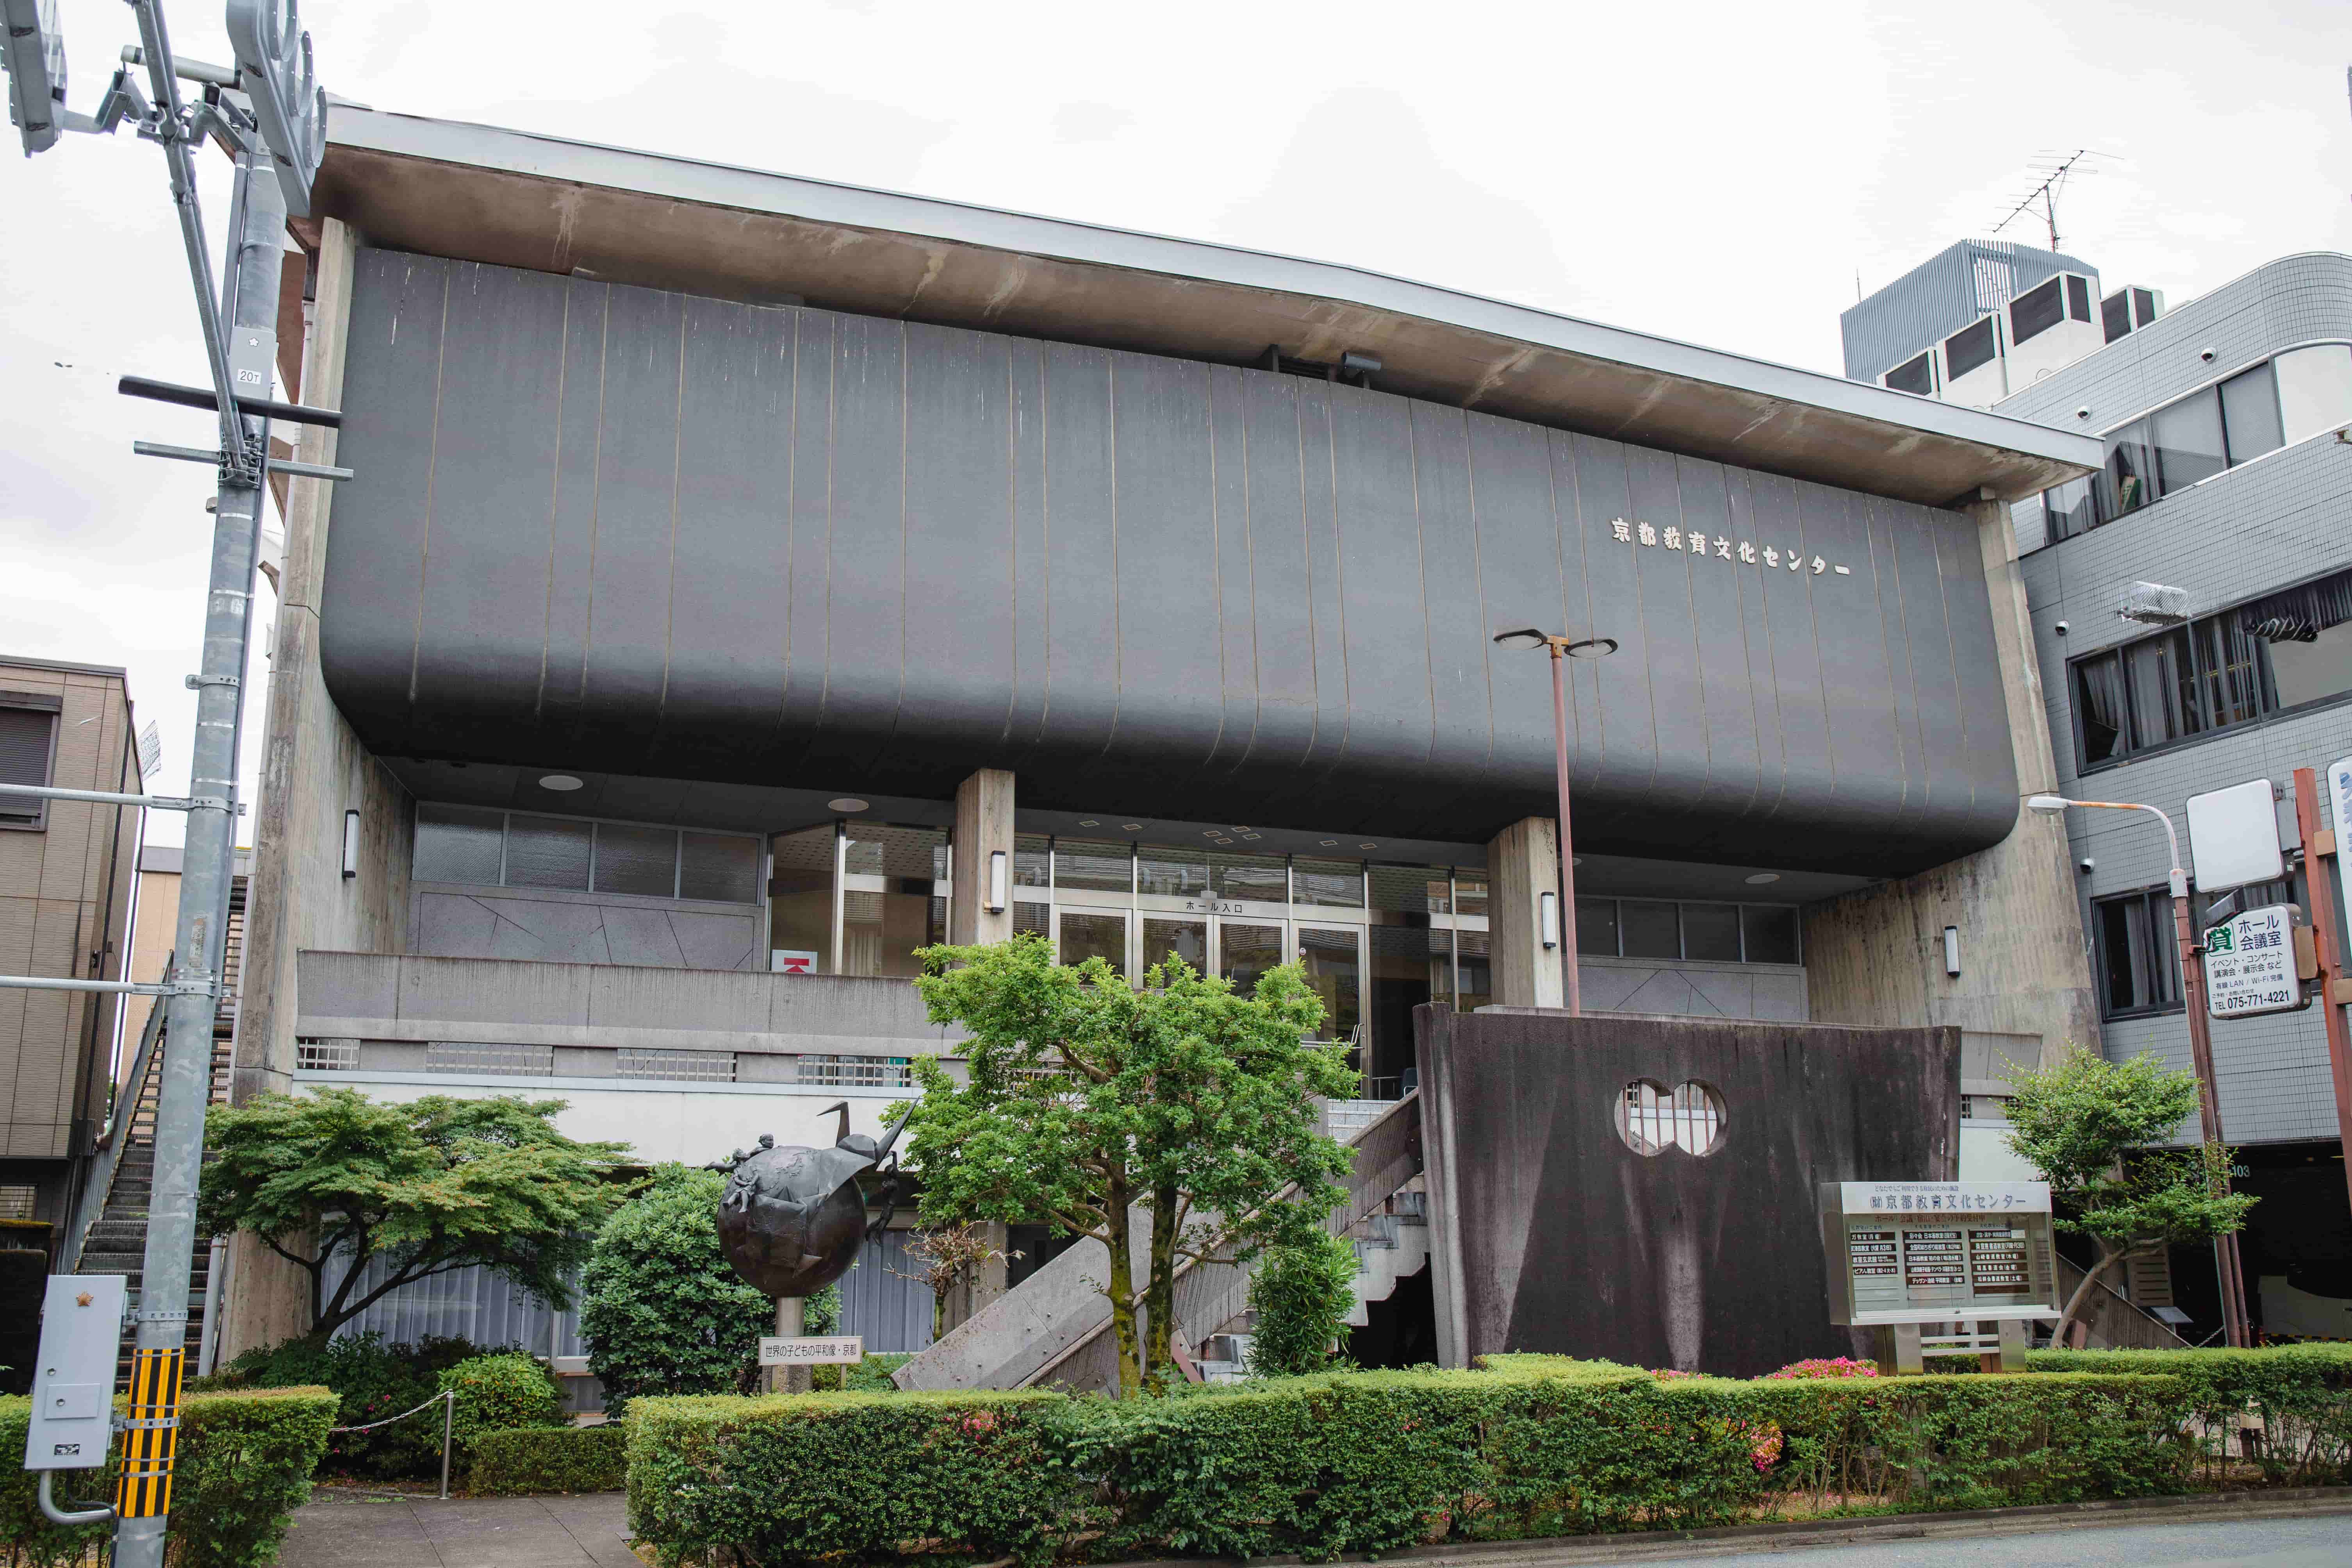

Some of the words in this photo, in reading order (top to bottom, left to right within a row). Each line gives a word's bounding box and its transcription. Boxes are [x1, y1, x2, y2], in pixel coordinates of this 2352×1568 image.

[1611, 516, 1851, 576] 京都教育文化センター
[1186, 901, 1243, 913] ホール入口
[2238, 914, 2279, 934] ホール
[2240, 931, 2282, 951] 会議室
[2211, 950, 2283, 969] イベント・コンサート
[2214, 963, 2265, 978] 講演会・展示会
[2267, 960, 2282, 969] など
[2229, 979, 2244, 988] LAN
[2251, 976, 2269, 985] Wi-Fi
[2215, 1001, 2225, 1010] TEL
[2227, 989, 2290, 1009] 075-771-4221
[766, 1343, 857, 1357] 世界の子どもの平和像・京都
